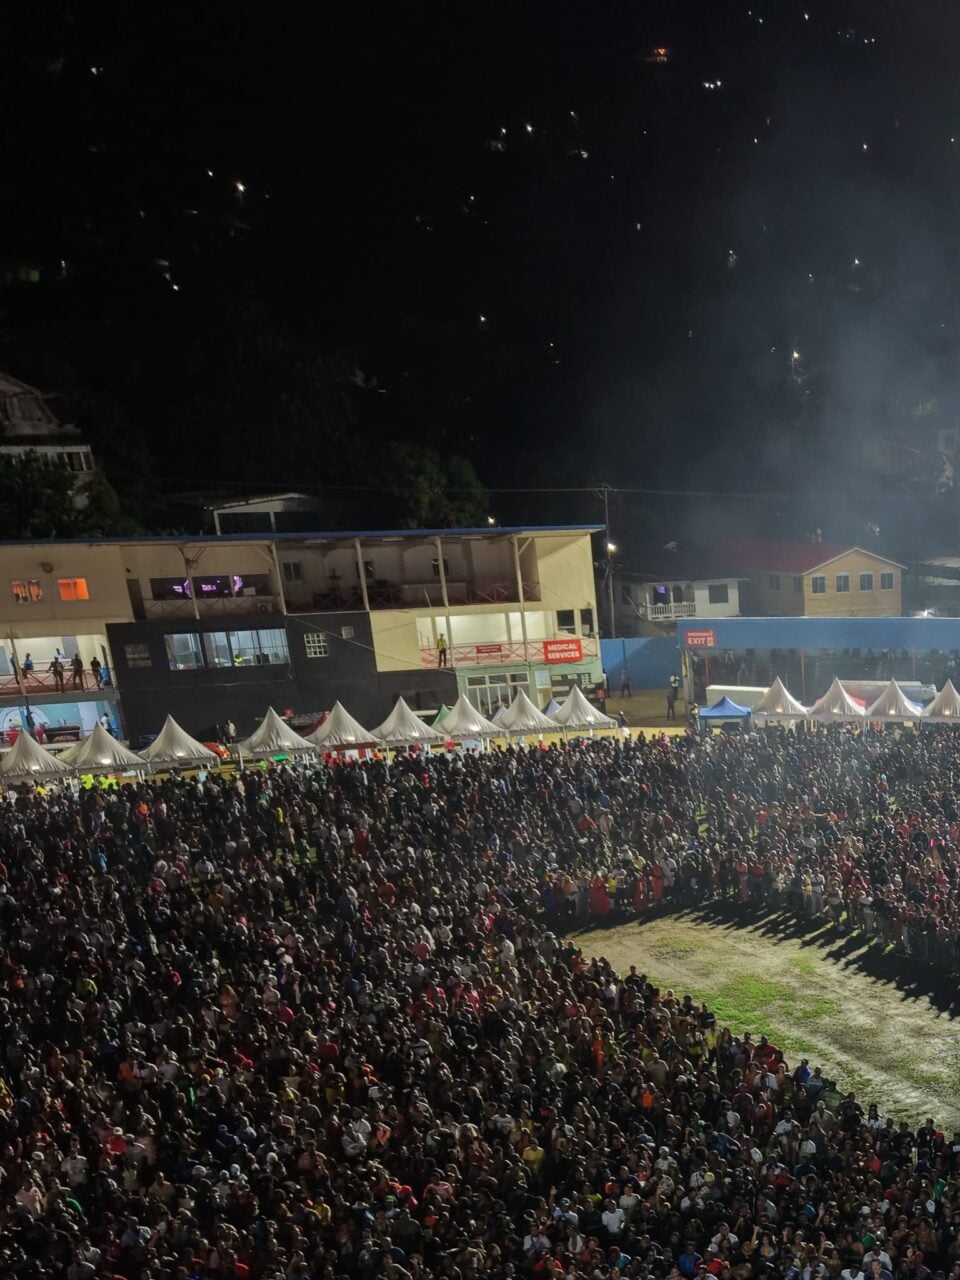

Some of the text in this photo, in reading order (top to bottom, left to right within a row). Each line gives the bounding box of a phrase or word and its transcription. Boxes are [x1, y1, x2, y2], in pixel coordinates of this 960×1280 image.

[688, 637, 706, 645] EXIT
[547, 642, 578, 651] MEDICAL
[547, 651, 580, 659] SERVICES
